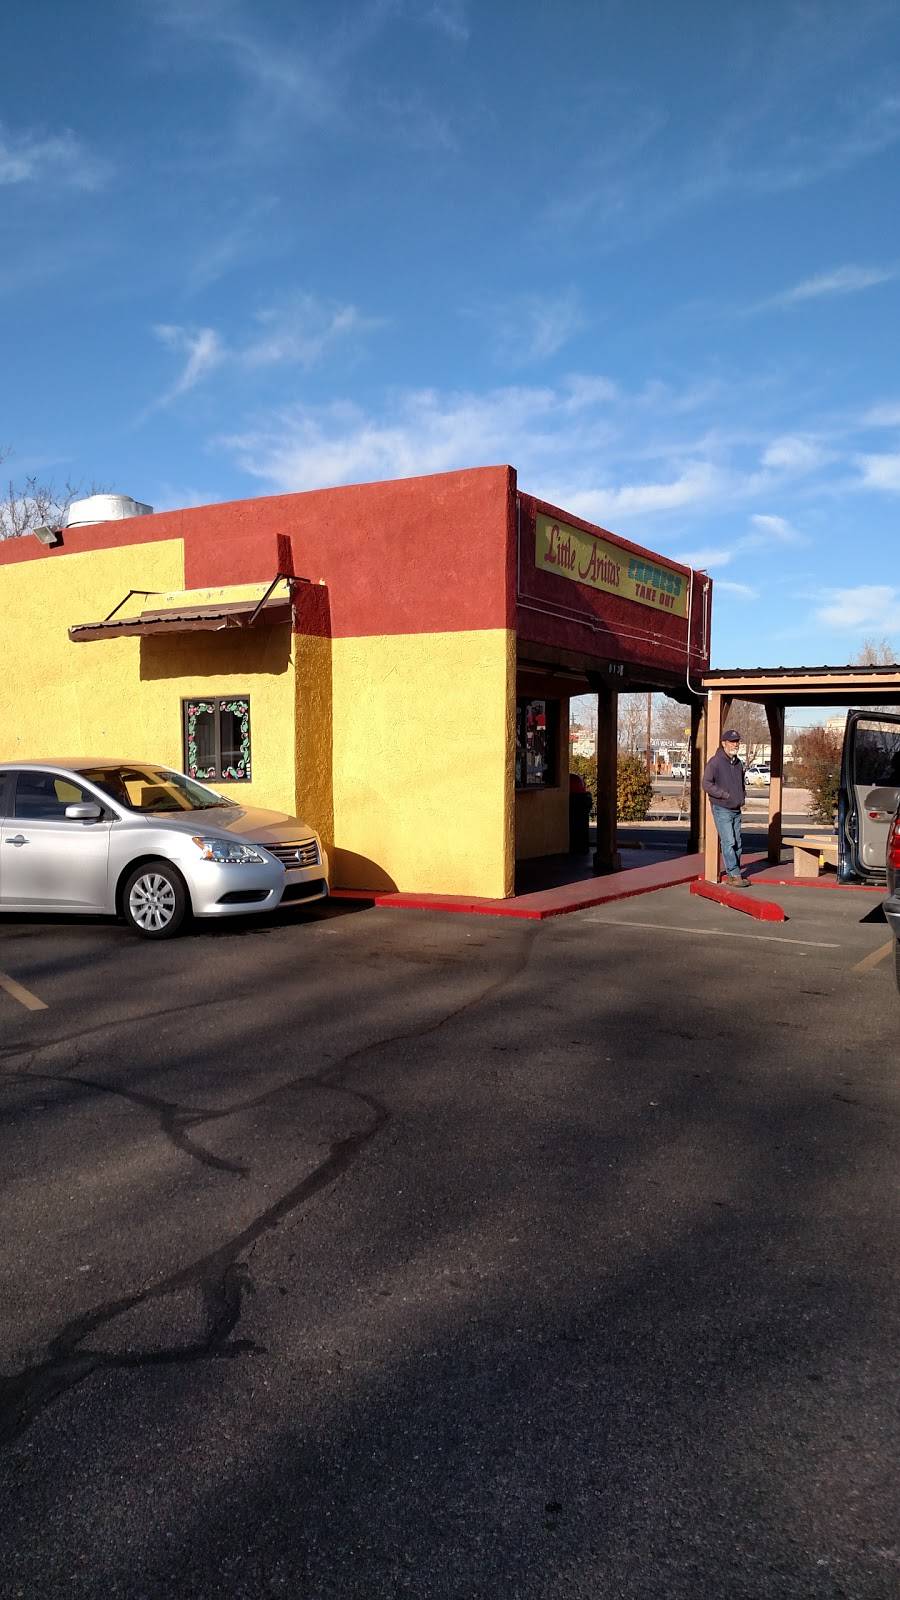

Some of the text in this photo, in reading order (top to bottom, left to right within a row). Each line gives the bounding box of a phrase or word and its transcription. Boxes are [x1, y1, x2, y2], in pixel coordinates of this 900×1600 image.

[544, 524, 576, 571] Little
[635, 583, 675, 609] TAKE OUT
